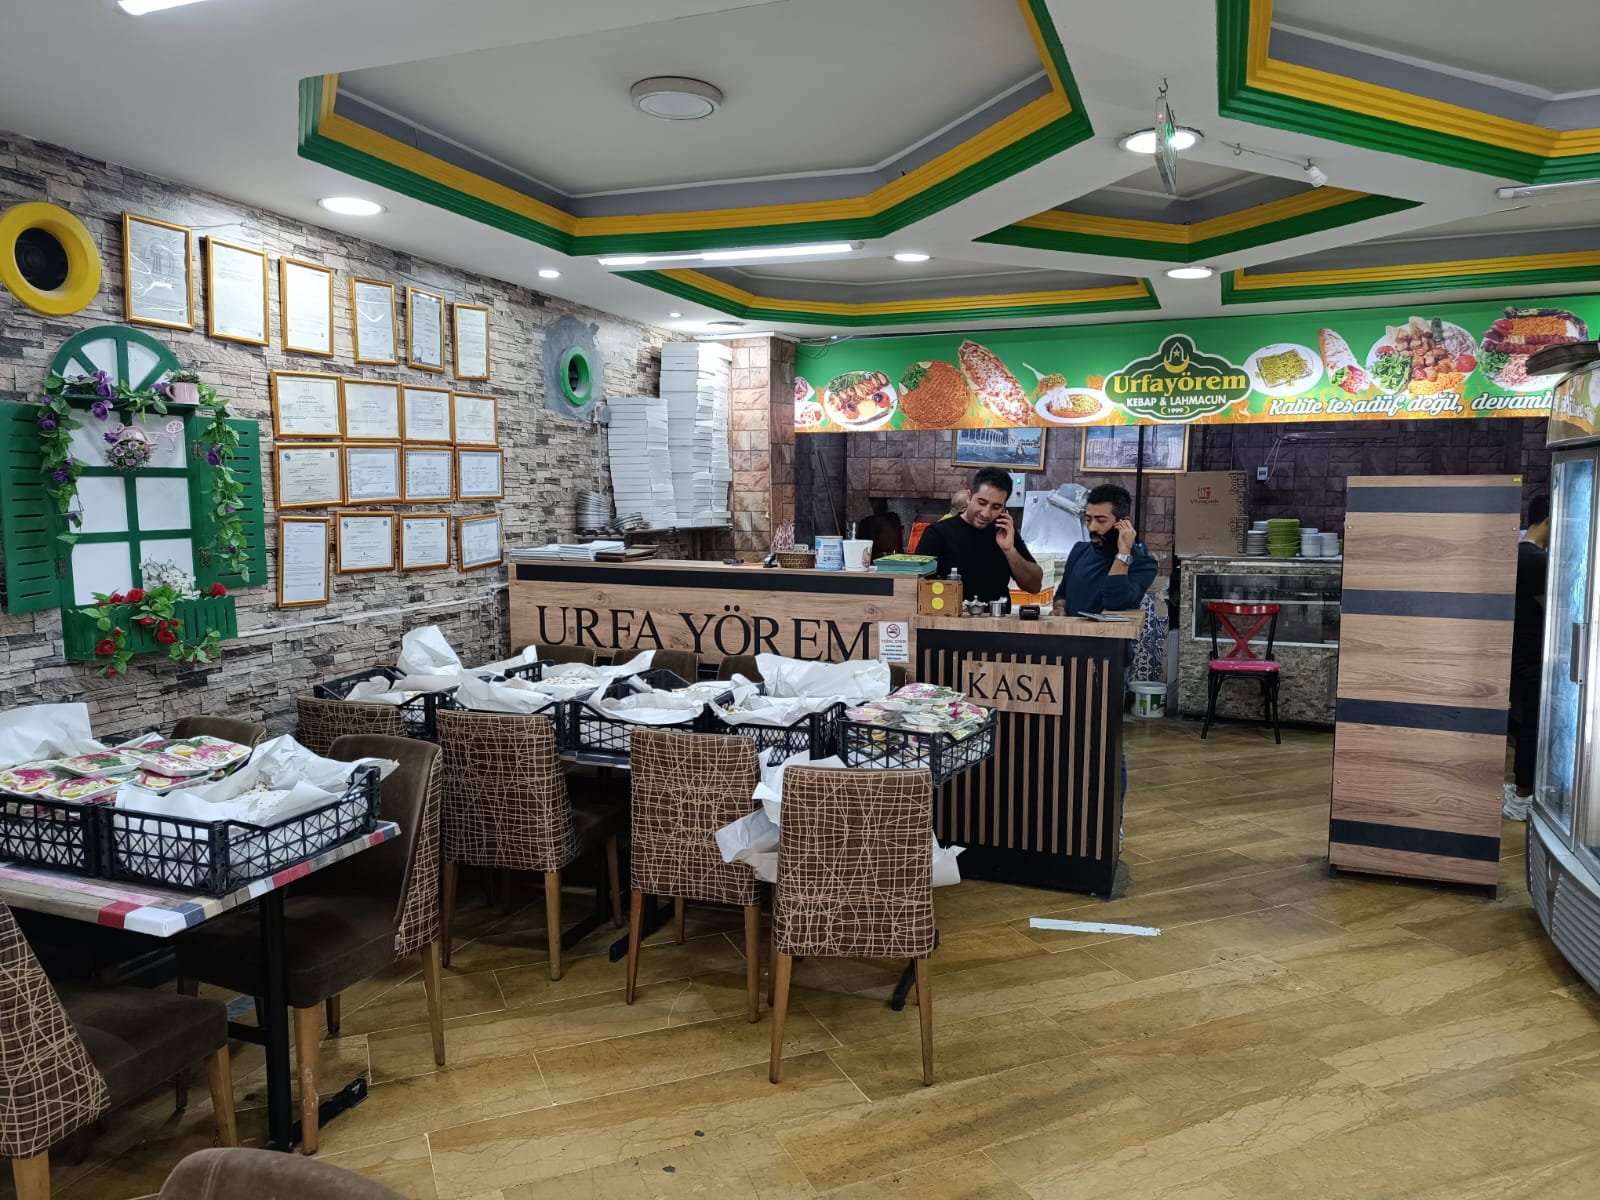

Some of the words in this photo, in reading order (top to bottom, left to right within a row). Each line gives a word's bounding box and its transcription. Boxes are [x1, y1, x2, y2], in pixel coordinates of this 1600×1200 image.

[1113, 372, 1247, 396] Urfayörem
[1126, 397, 1157, 407] KEBAP
[1159, 396, 1167, 406] &
[1170, 395, 1227, 405] LAHMACUN
[1269, 398, 1323, 416] Kalite
[1326, 394, 1405, 417] tesadüf
[1408, 392, 1464, 416] değil,
[535, 605, 665, 650] URFA
[678, 604, 873, 663] YÖREM
[967, 672, 1057, 704] KASA
